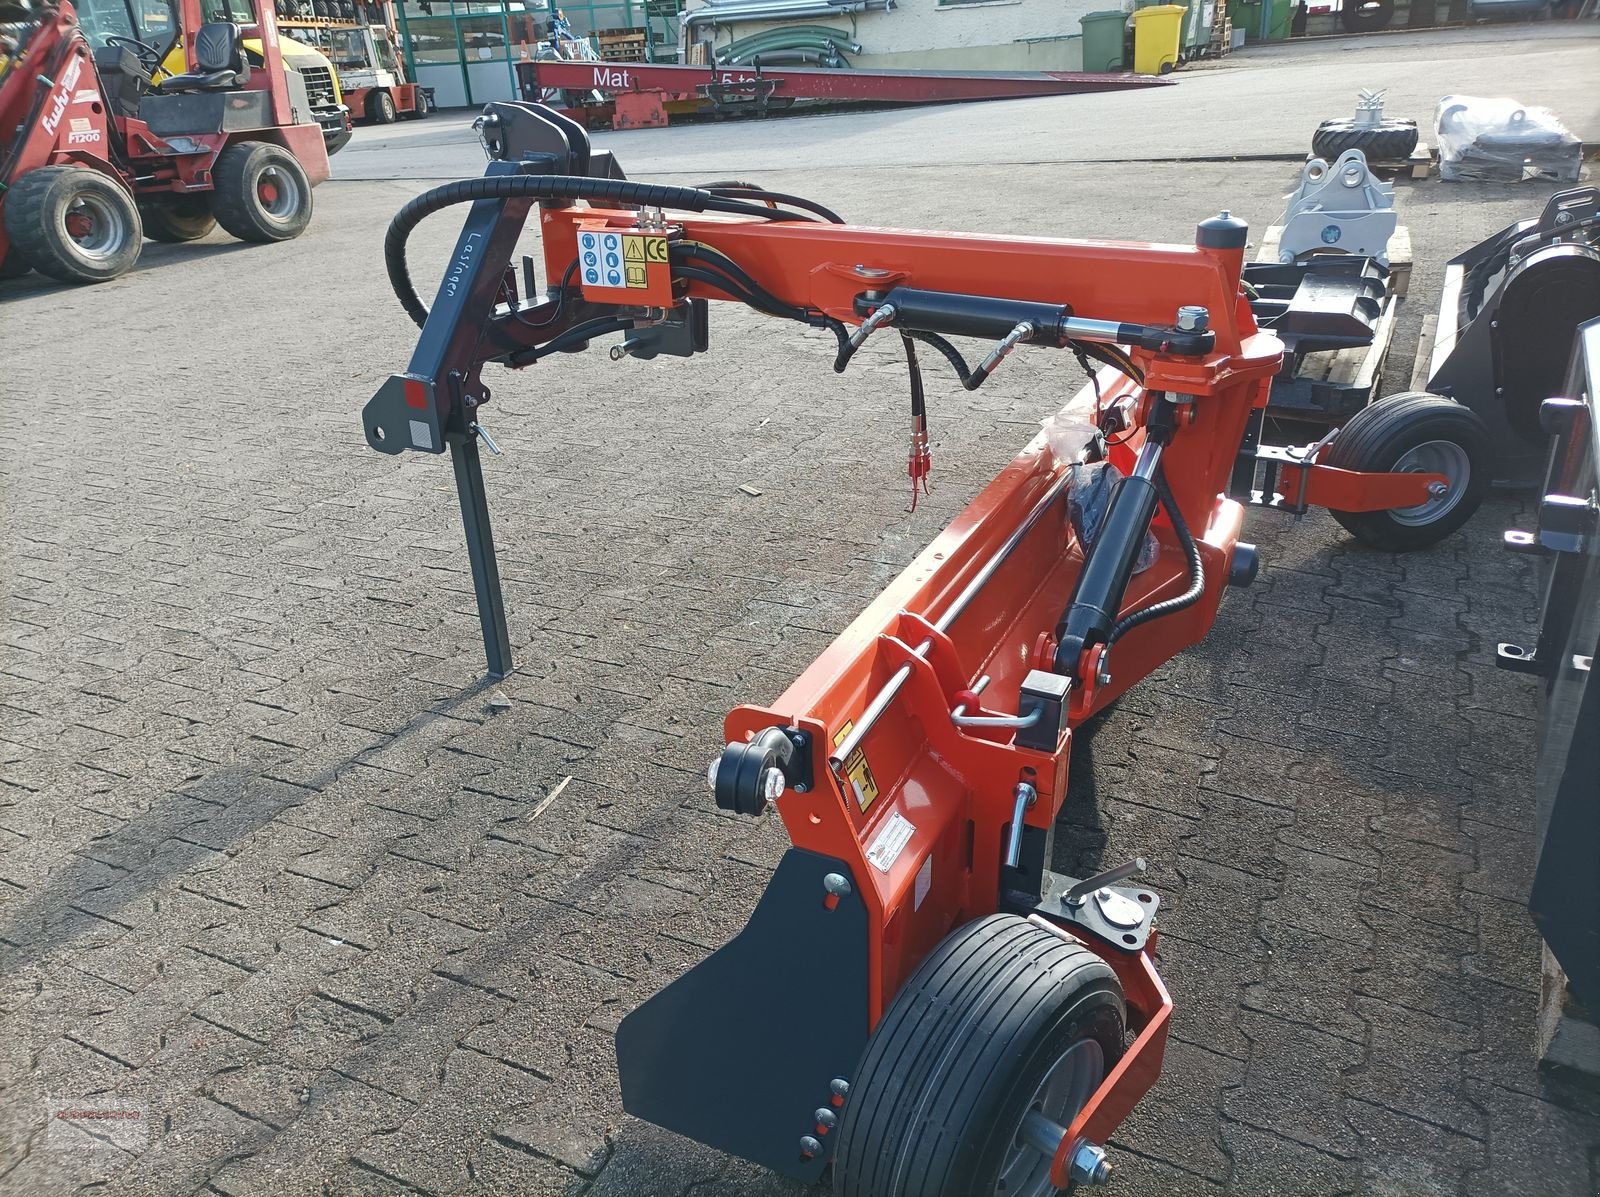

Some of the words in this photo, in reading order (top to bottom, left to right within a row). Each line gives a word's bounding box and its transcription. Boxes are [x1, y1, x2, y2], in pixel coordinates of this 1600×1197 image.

[593, 67, 629, 88] Mat
[67, 129, 101, 145] F1200
[646, 238, 667, 261] CE
